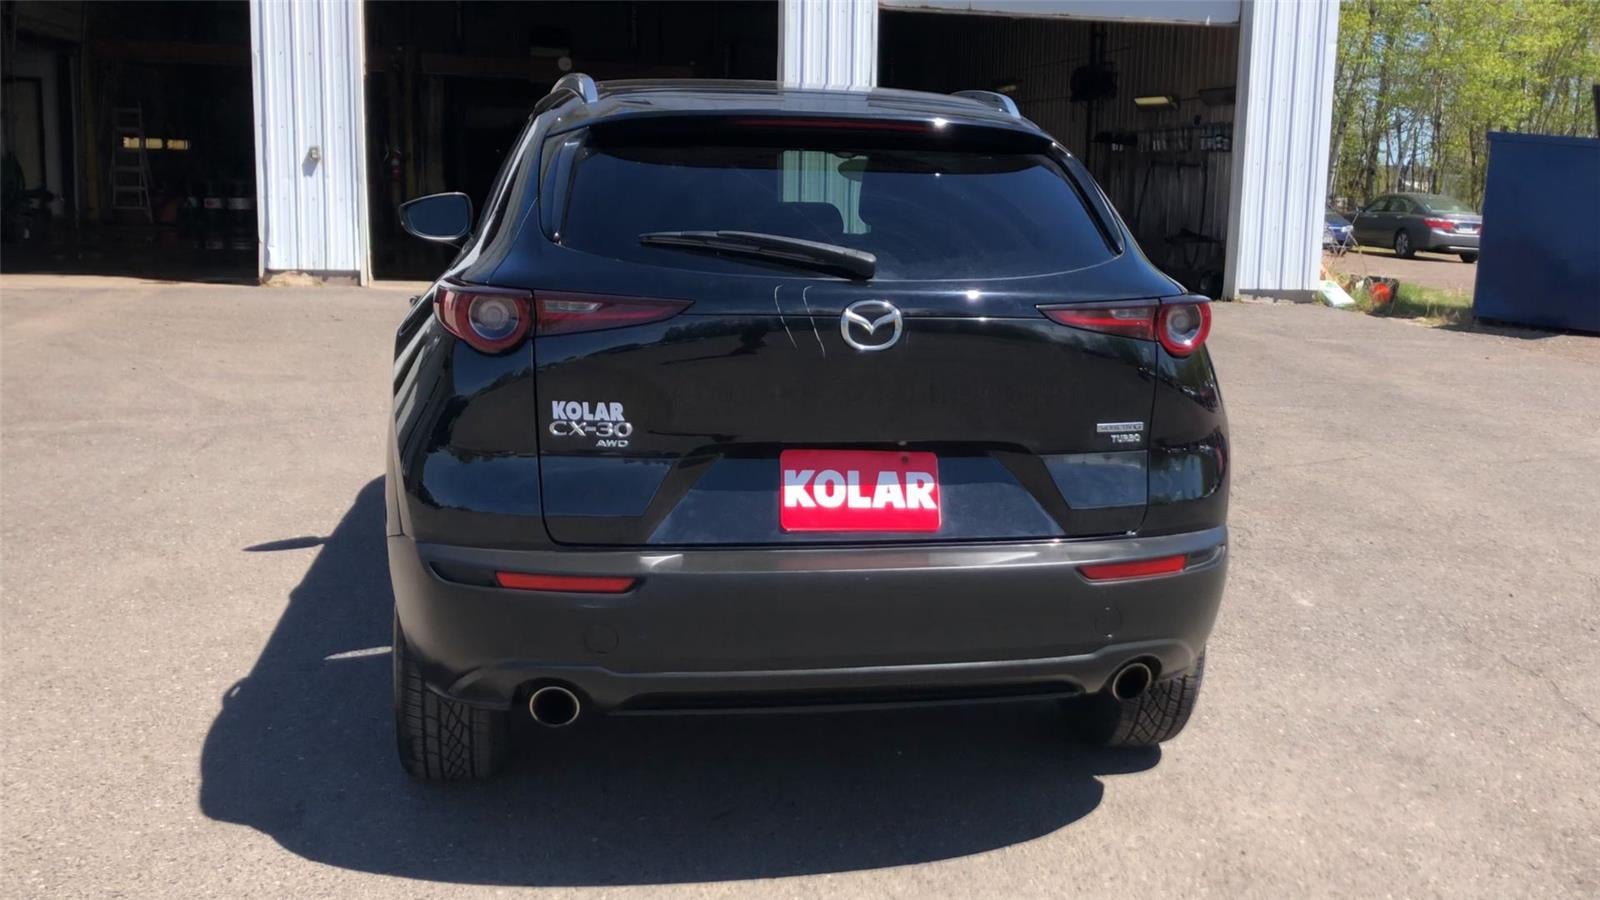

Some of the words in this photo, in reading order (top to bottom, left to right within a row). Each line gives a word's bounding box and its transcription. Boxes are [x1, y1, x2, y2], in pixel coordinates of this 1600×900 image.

[552, 401, 625, 421] KOLAR
[549, 421, 633, 438] CX-30
[1111, 433, 1141, 443] TURBO
[596, 440, 629, 448] AWD
[784, 469, 938, 509] KOLAR
